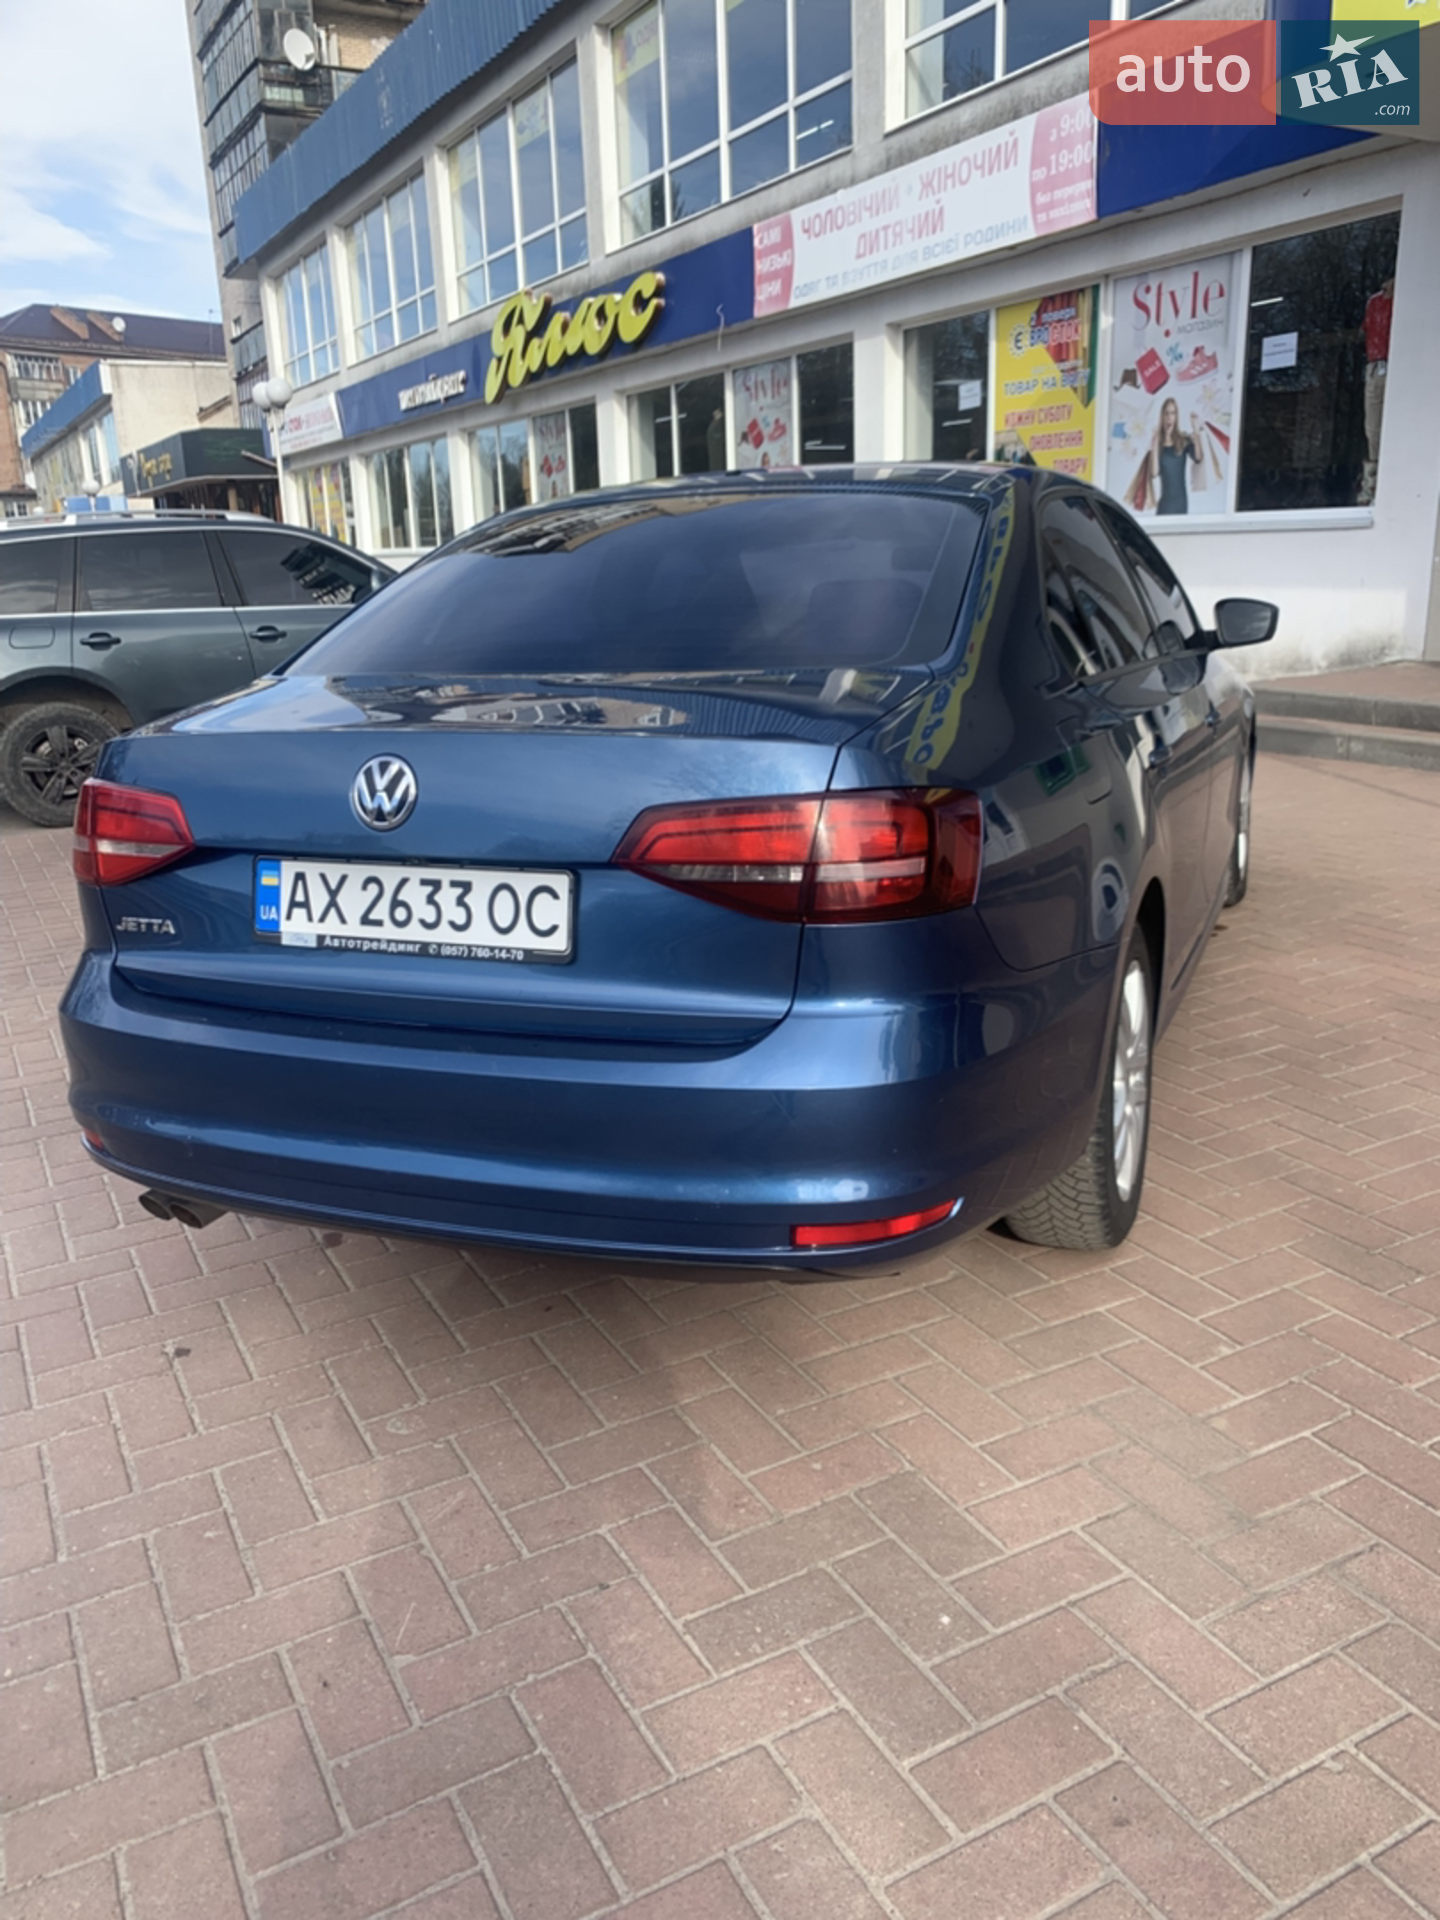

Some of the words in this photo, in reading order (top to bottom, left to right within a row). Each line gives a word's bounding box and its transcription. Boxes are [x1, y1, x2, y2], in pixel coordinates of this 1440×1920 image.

[1049, 140, 1095, 175] 19:00
[801, 175, 900, 241] ЧОЛОВІЧИЙ
[918, 129, 1019, 201] ЖІНОЧИЙ
[855, 199, 945, 260] ДИТЯЧИЙ
[922, 232, 959, 262] ВСІЄЇ
[963, 215, 1028, 248] РОДИНИ
[1132, 270, 1226, 338] Style
[1004, 378, 1039, 396] ТОВАР
[1042, 375, 1057, 390] НА
[260, 904, 279, 921] UA
[286, 871, 349, 925] AX
[359, 876, 473, 933] 2633
[488, 882, 561, 938] OC
[116, 916, 176, 935] JETTA
[323, 935, 421, 954] Автотрейдинг
